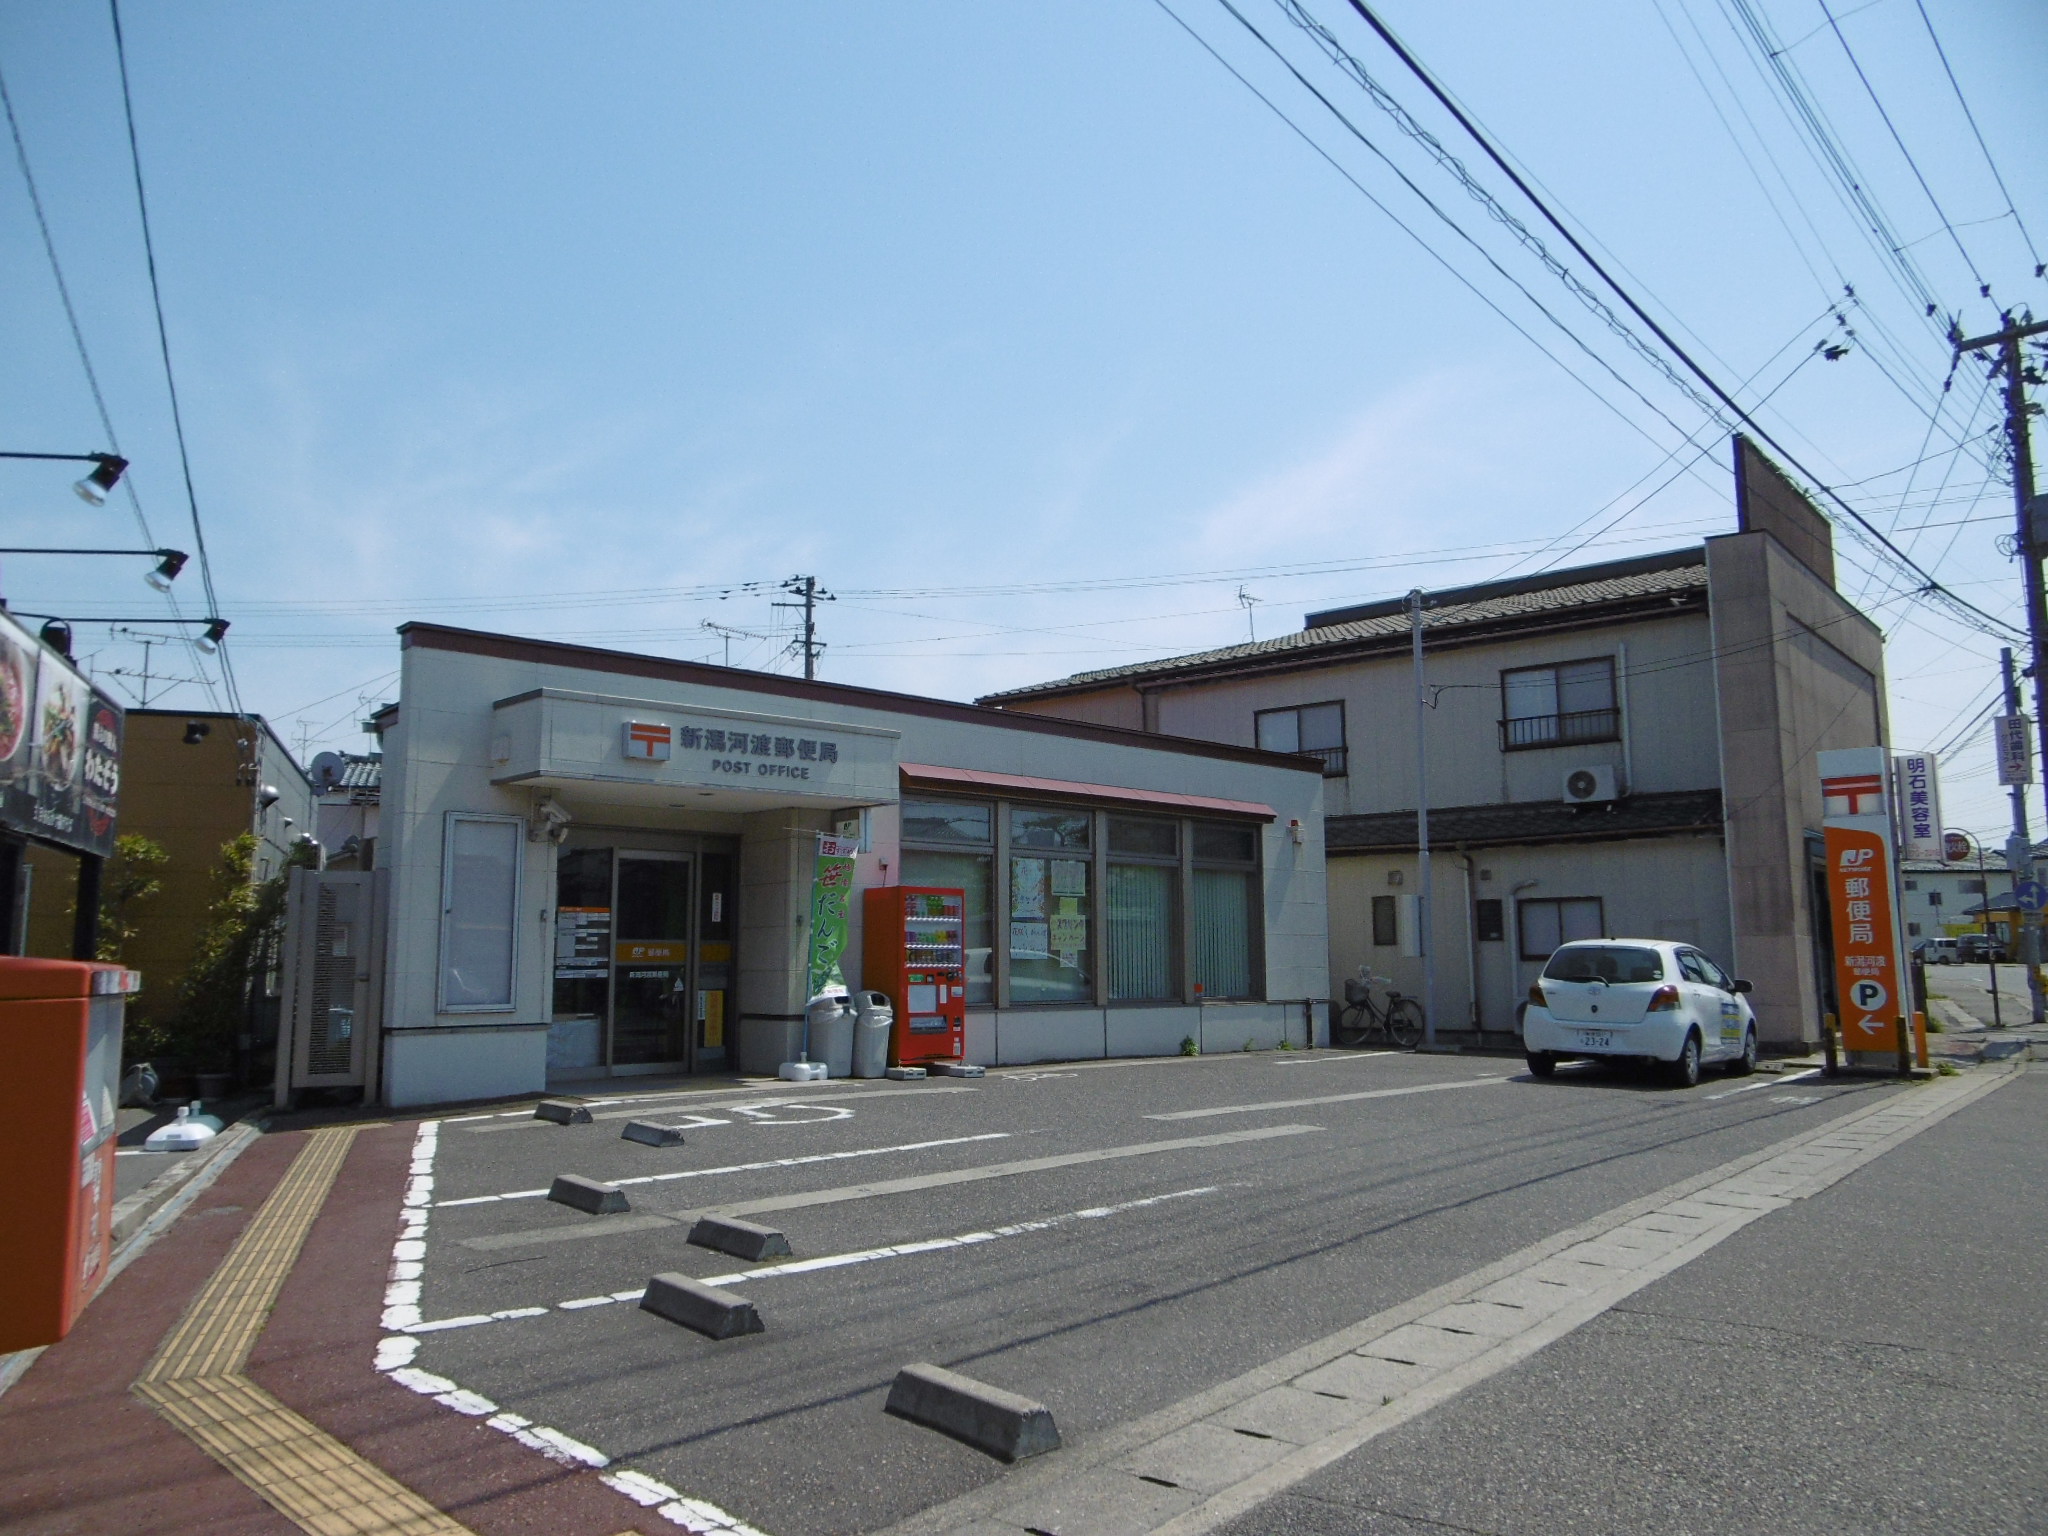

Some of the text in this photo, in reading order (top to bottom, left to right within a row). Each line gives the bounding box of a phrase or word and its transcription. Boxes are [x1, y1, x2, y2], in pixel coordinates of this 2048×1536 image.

[680, 725, 838, 764] 新潟河渡郵便局
[2008, 718, 2025, 762] 田代歯科
[712, 759, 809, 780] POST OFFICE
[1907, 758, 1932, 839] 明石美容室
[817, 864, 843, 965] 笹だんご
[1845, 877, 1874, 944] 郵便局
[1860, 984, 1879, 1006] P
